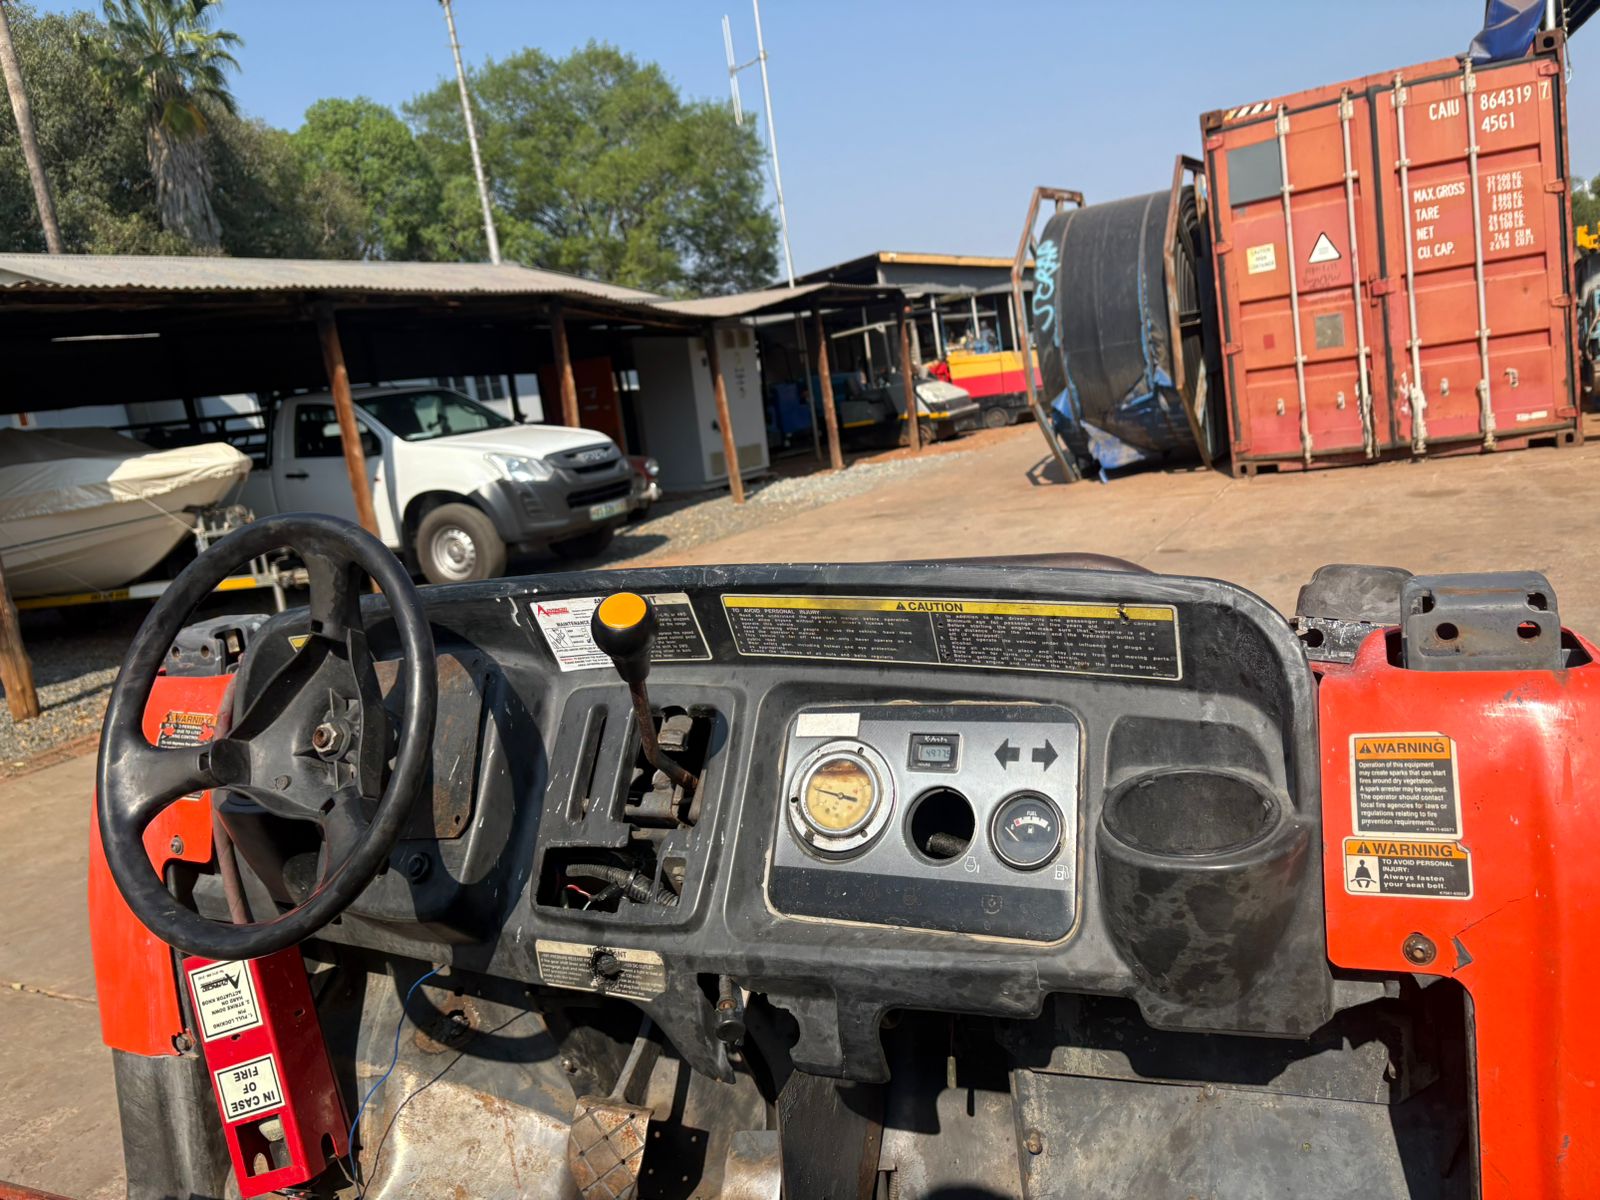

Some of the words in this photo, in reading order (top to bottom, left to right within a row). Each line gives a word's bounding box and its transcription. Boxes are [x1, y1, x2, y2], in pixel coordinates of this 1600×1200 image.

[1429, 99, 1459, 120] CAIU
[1480, 86, 1531, 111] 864319
[1540, 82, 1549, 99] 7
[1482, 112, 1514, 133] 45G1
[1416, 206, 1439, 222] TARE
[1416, 226, 1434, 241] NET
[1418, 244, 1432, 259] CU.
[1435, 242, 1454, 257] CAP.
[908, 602, 963, 611] CAUTION
[1374, 742, 1444, 753] WARNING
[1396, 810, 1418, 818] relating
[1373, 843, 1453, 856] WARNING
[202, 997, 217, 1006] KNOB
[217, 990, 241, 1002] ACTUATOR
[229, 995, 243, 1004] HARD
[211, 1006, 226, 1015] DOWN
[227, 1001, 244, 1011] STRIKE
[213, 1018, 234, 1029] LOCKING
[235, 1014, 248, 1024] PULL
[233, 1066, 258, 1082] FIRE
[243, 1082, 257, 1094] OF
[263, 1090, 275, 1102] IN
[231, 1095, 262, 1112] CASE
